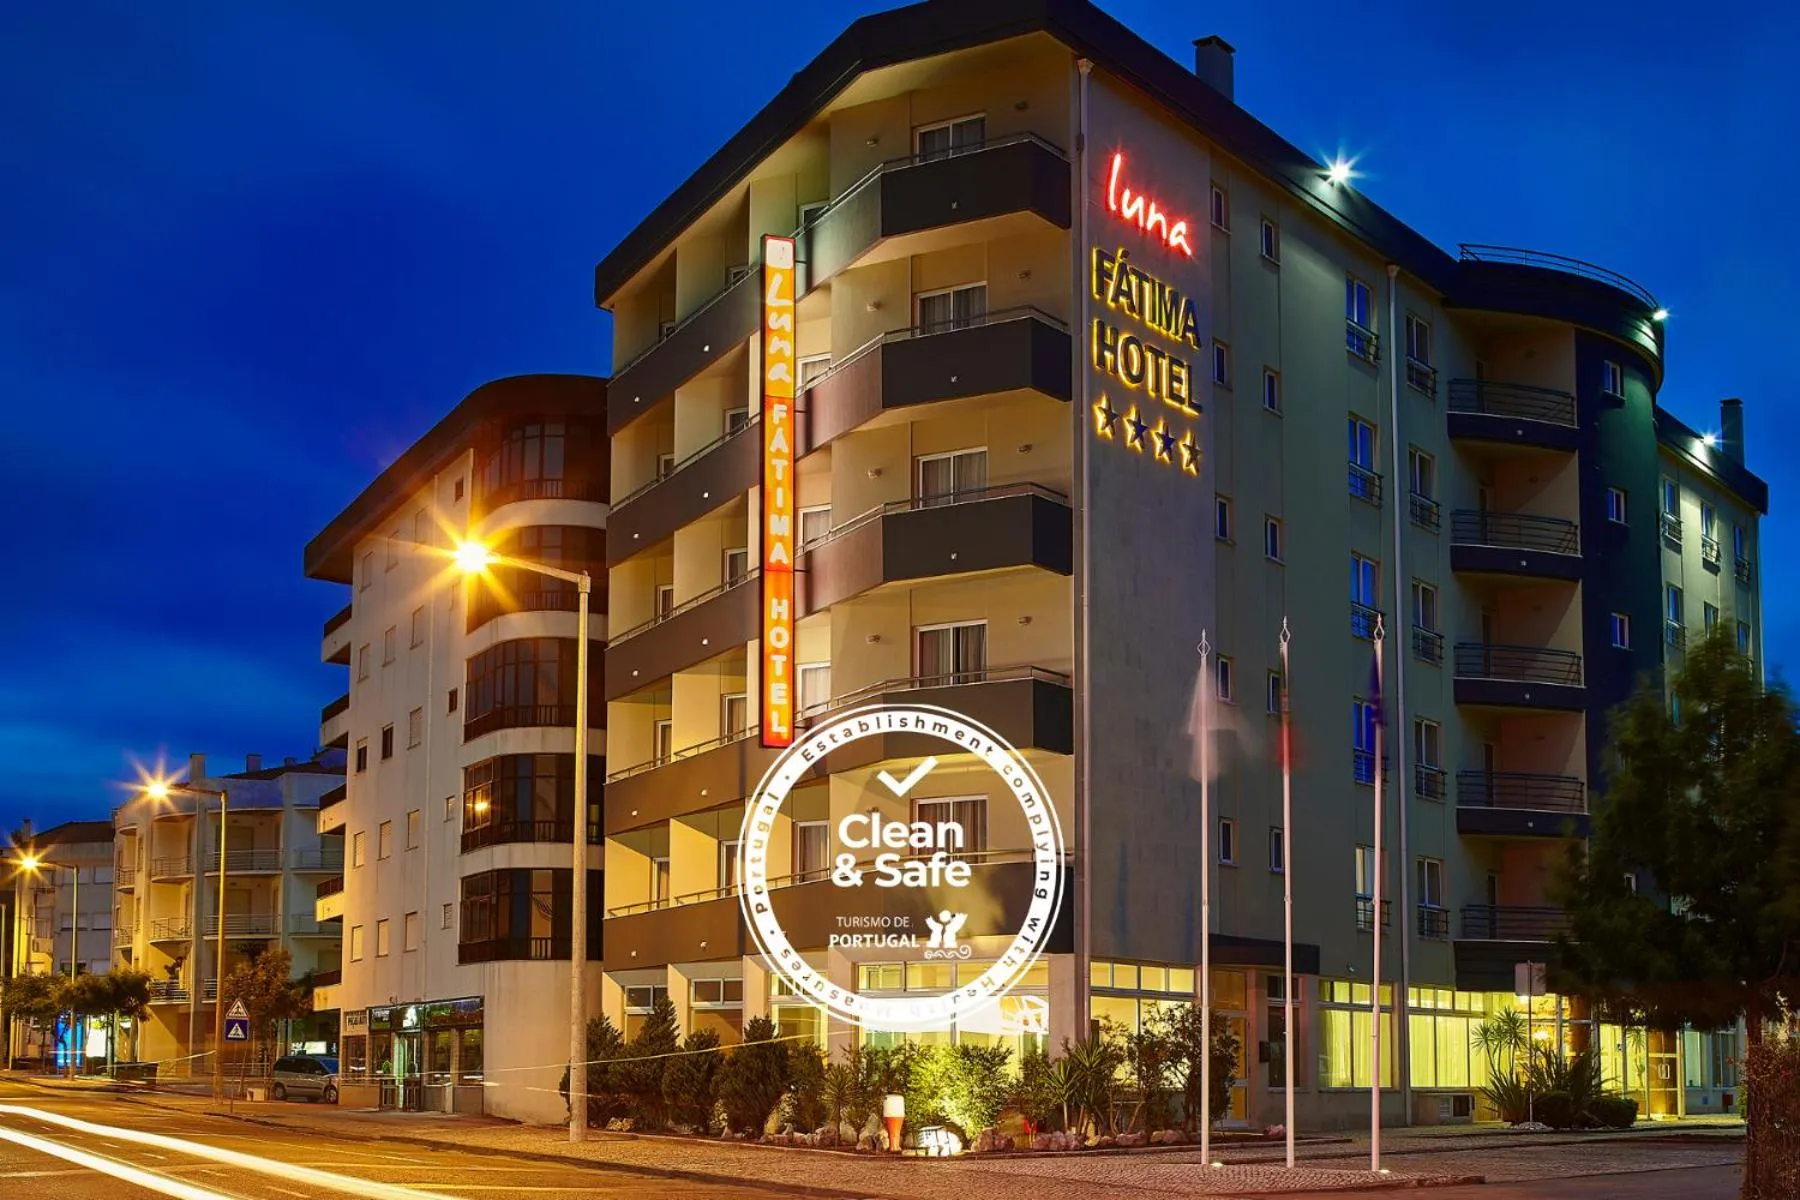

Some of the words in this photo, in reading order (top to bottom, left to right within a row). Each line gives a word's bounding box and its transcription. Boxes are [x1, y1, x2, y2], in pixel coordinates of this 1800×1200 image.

[1108, 153, 1191, 256] luna
[1093, 248, 1200, 349] FÁTIMA
[1093, 319, 1202, 415] HOTEL
[770, 598, 789, 733] HOTEL
